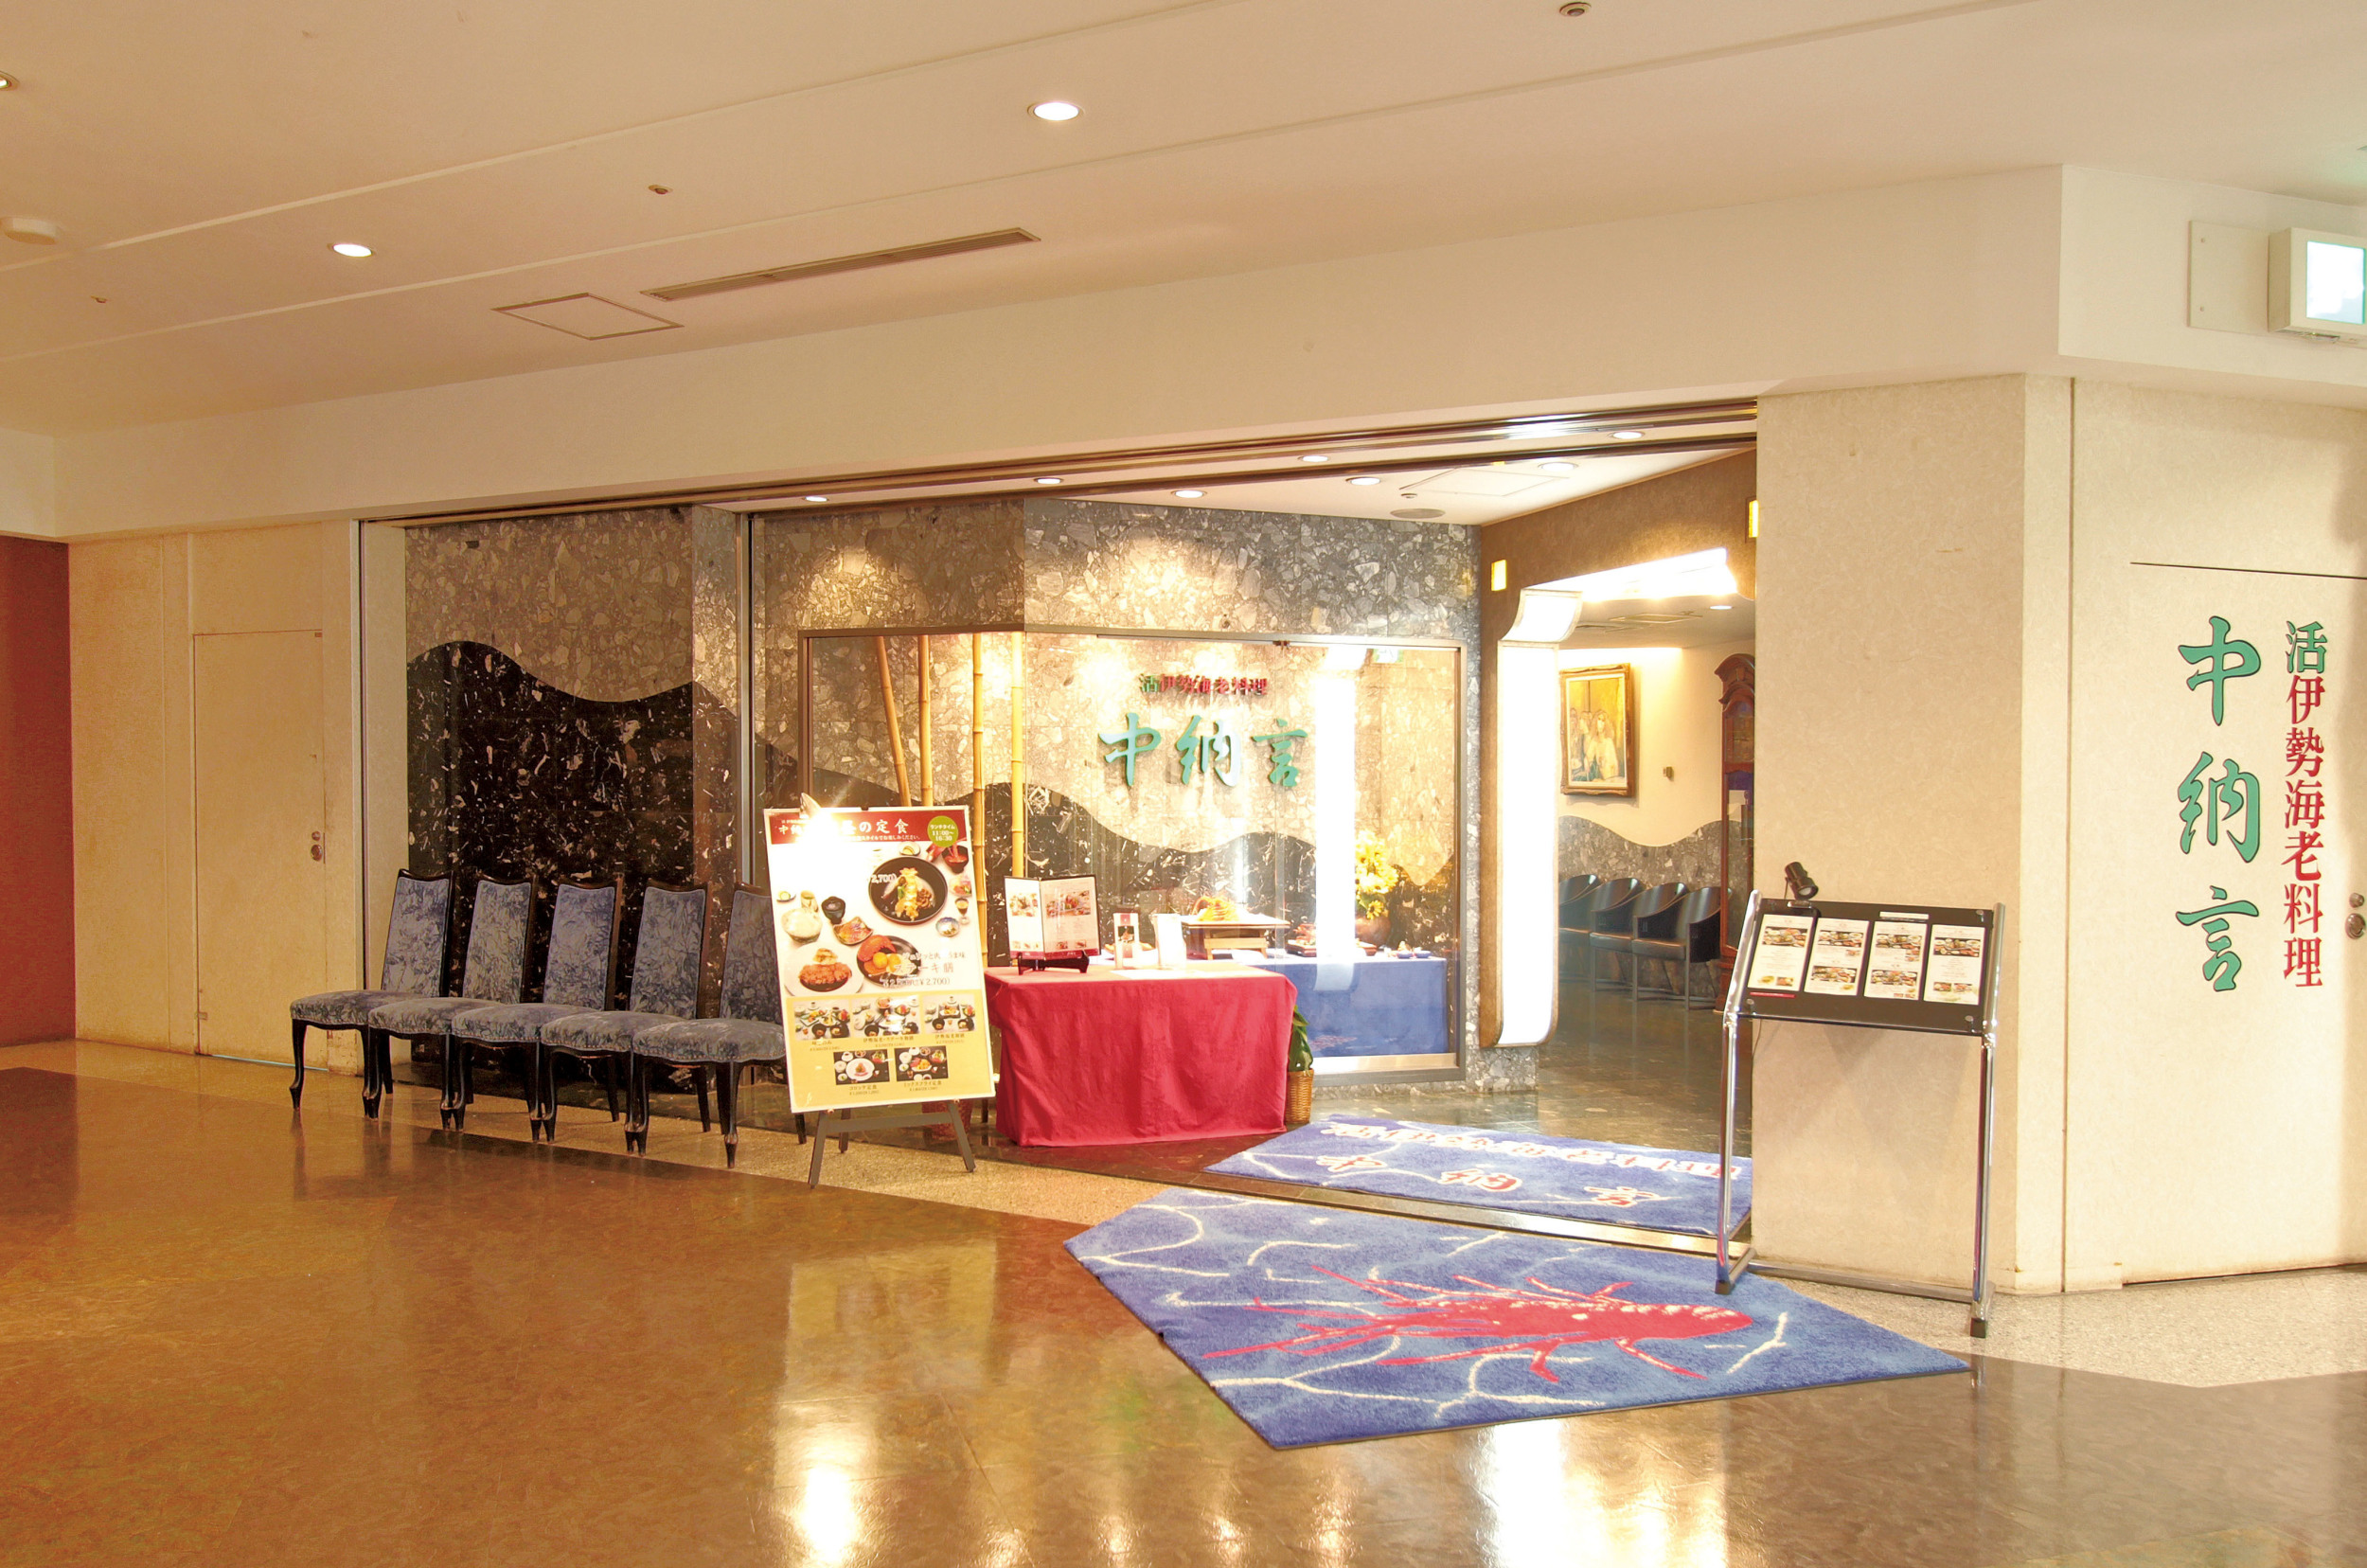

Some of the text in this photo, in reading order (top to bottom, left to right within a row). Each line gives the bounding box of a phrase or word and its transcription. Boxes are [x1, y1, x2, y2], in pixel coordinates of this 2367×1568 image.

[1098, 712, 1308, 788] 中納言
[2176, 615, 2261, 992] 中納言
[2281, 620, 2328, 988] 活伊勢海老料理
